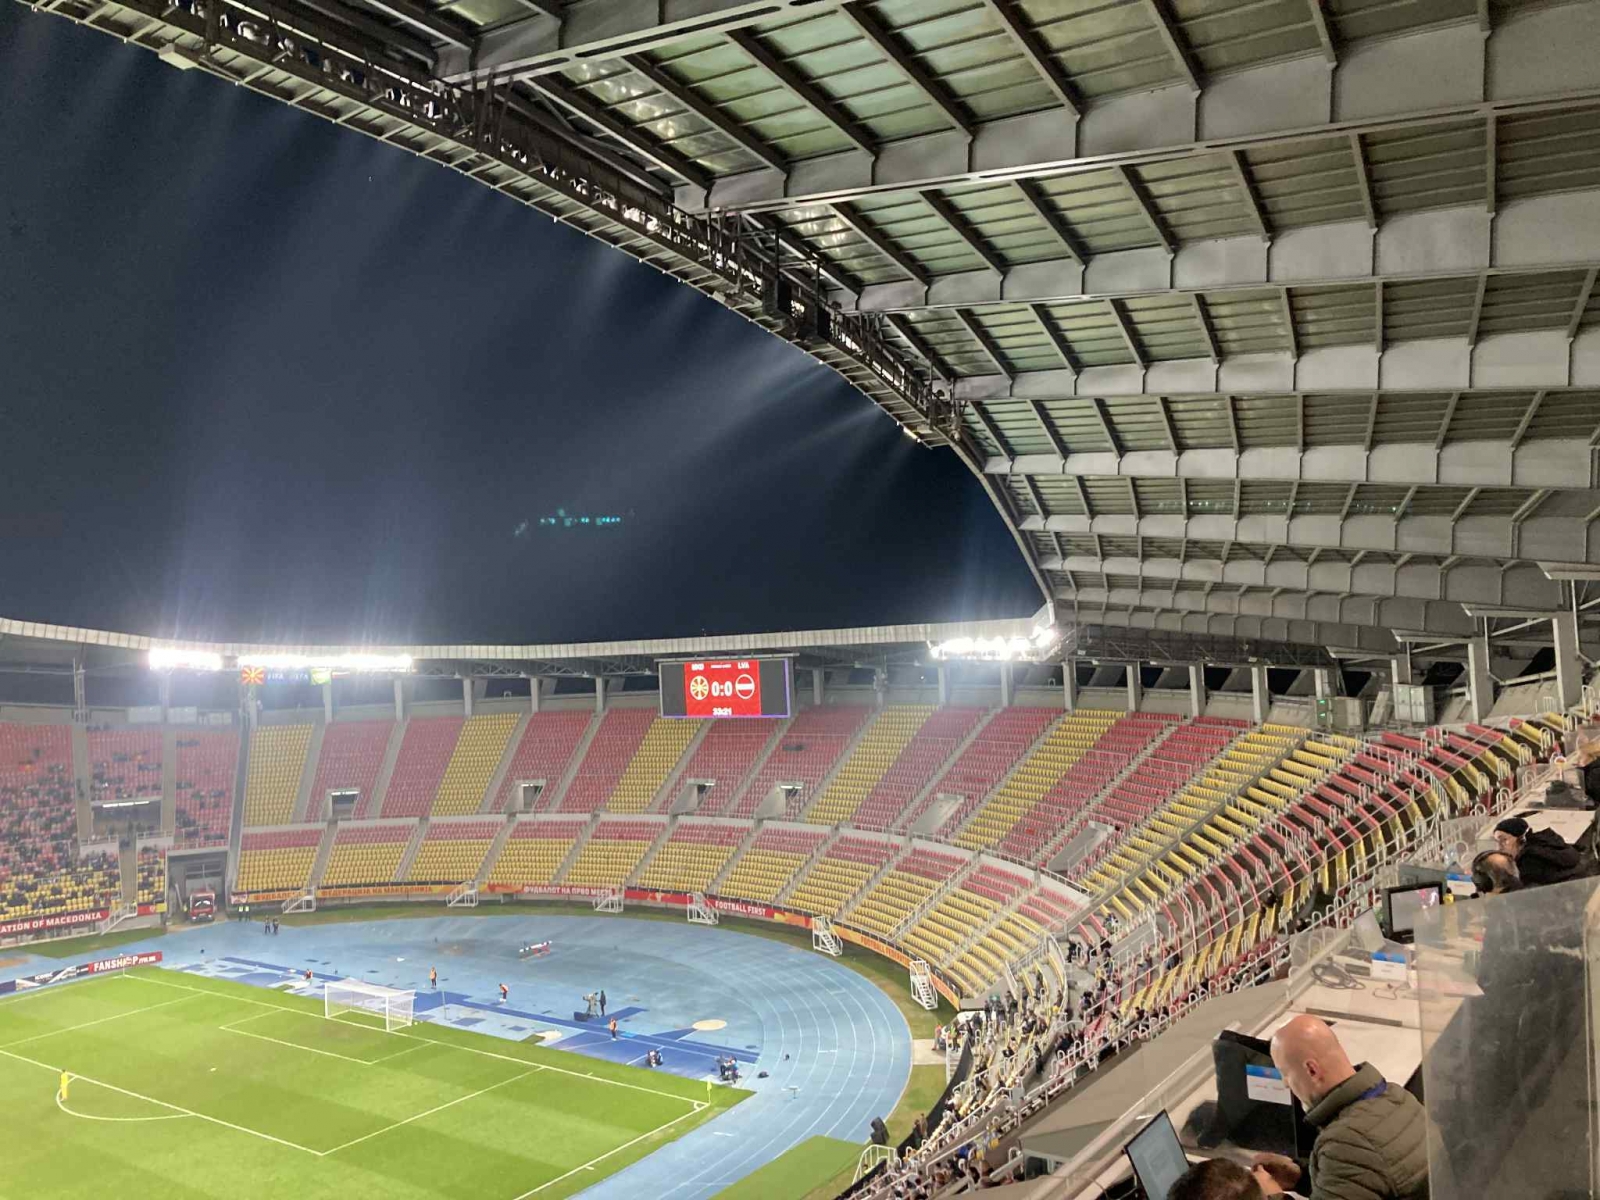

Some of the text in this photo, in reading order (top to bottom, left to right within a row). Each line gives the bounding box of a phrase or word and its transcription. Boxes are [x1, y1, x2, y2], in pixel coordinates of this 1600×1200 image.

[711, 681, 733, 697] 0:0
[715, 900, 766, 916] FOOTBALL FIRST
[32, 920, 45, 929] OF
[46, 911, 102, 926] MACEDONIA
